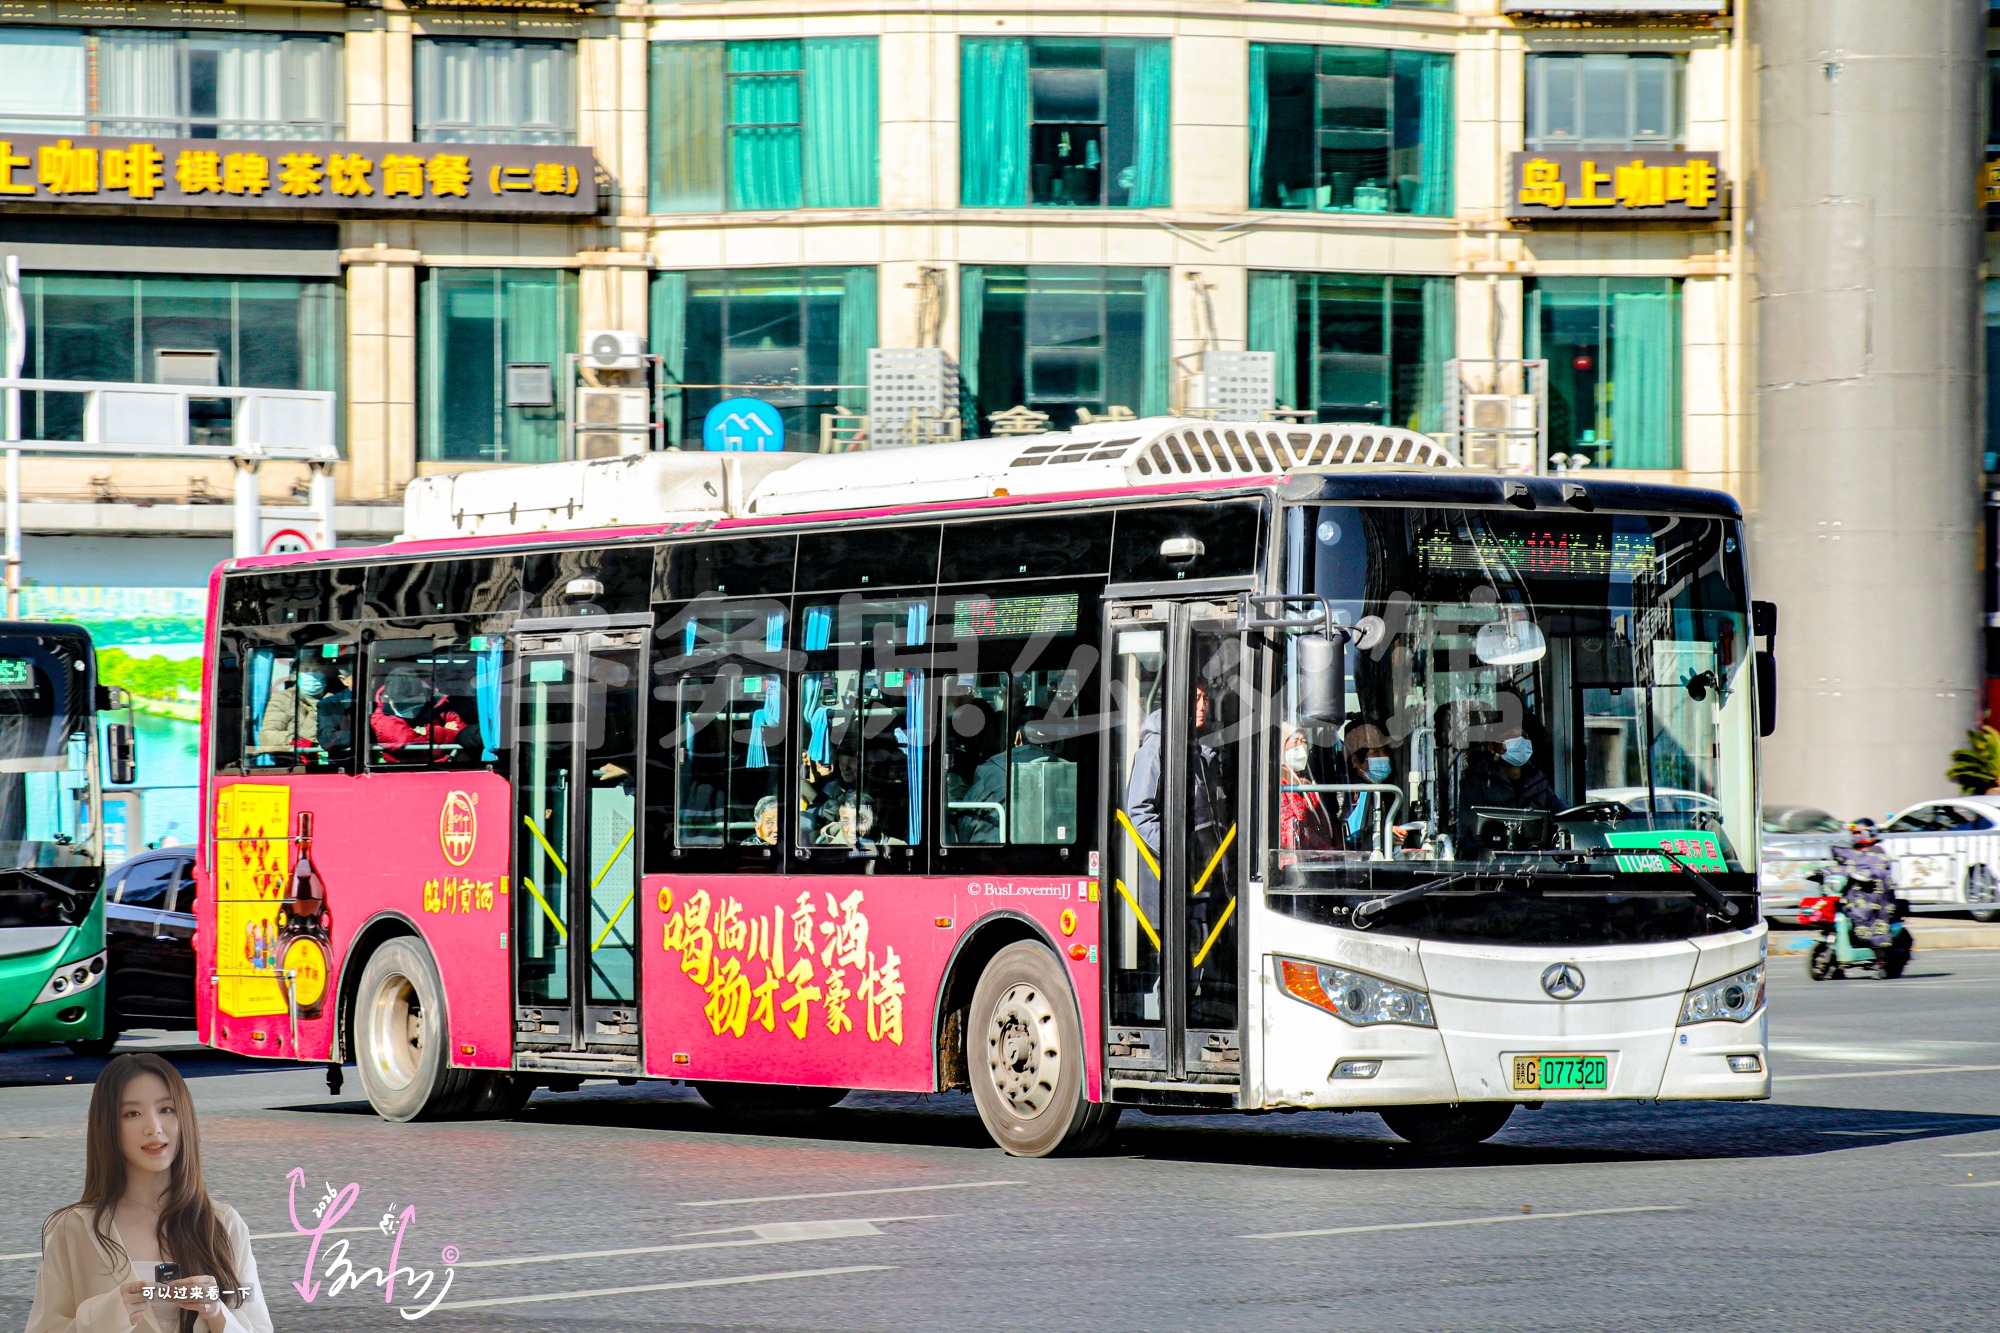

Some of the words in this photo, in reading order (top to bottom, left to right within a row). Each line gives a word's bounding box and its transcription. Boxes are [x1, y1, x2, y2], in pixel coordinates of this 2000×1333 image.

[1519, 158, 1718, 208] 岛上咖啡
[1659, 839, 1718, 859] 空调开启
[663, 889, 869, 986] 喝临川贡酒
[703, 946, 906, 1047] 扬才子豪情
[1544, 1061, 1605, 1084] 07732D
